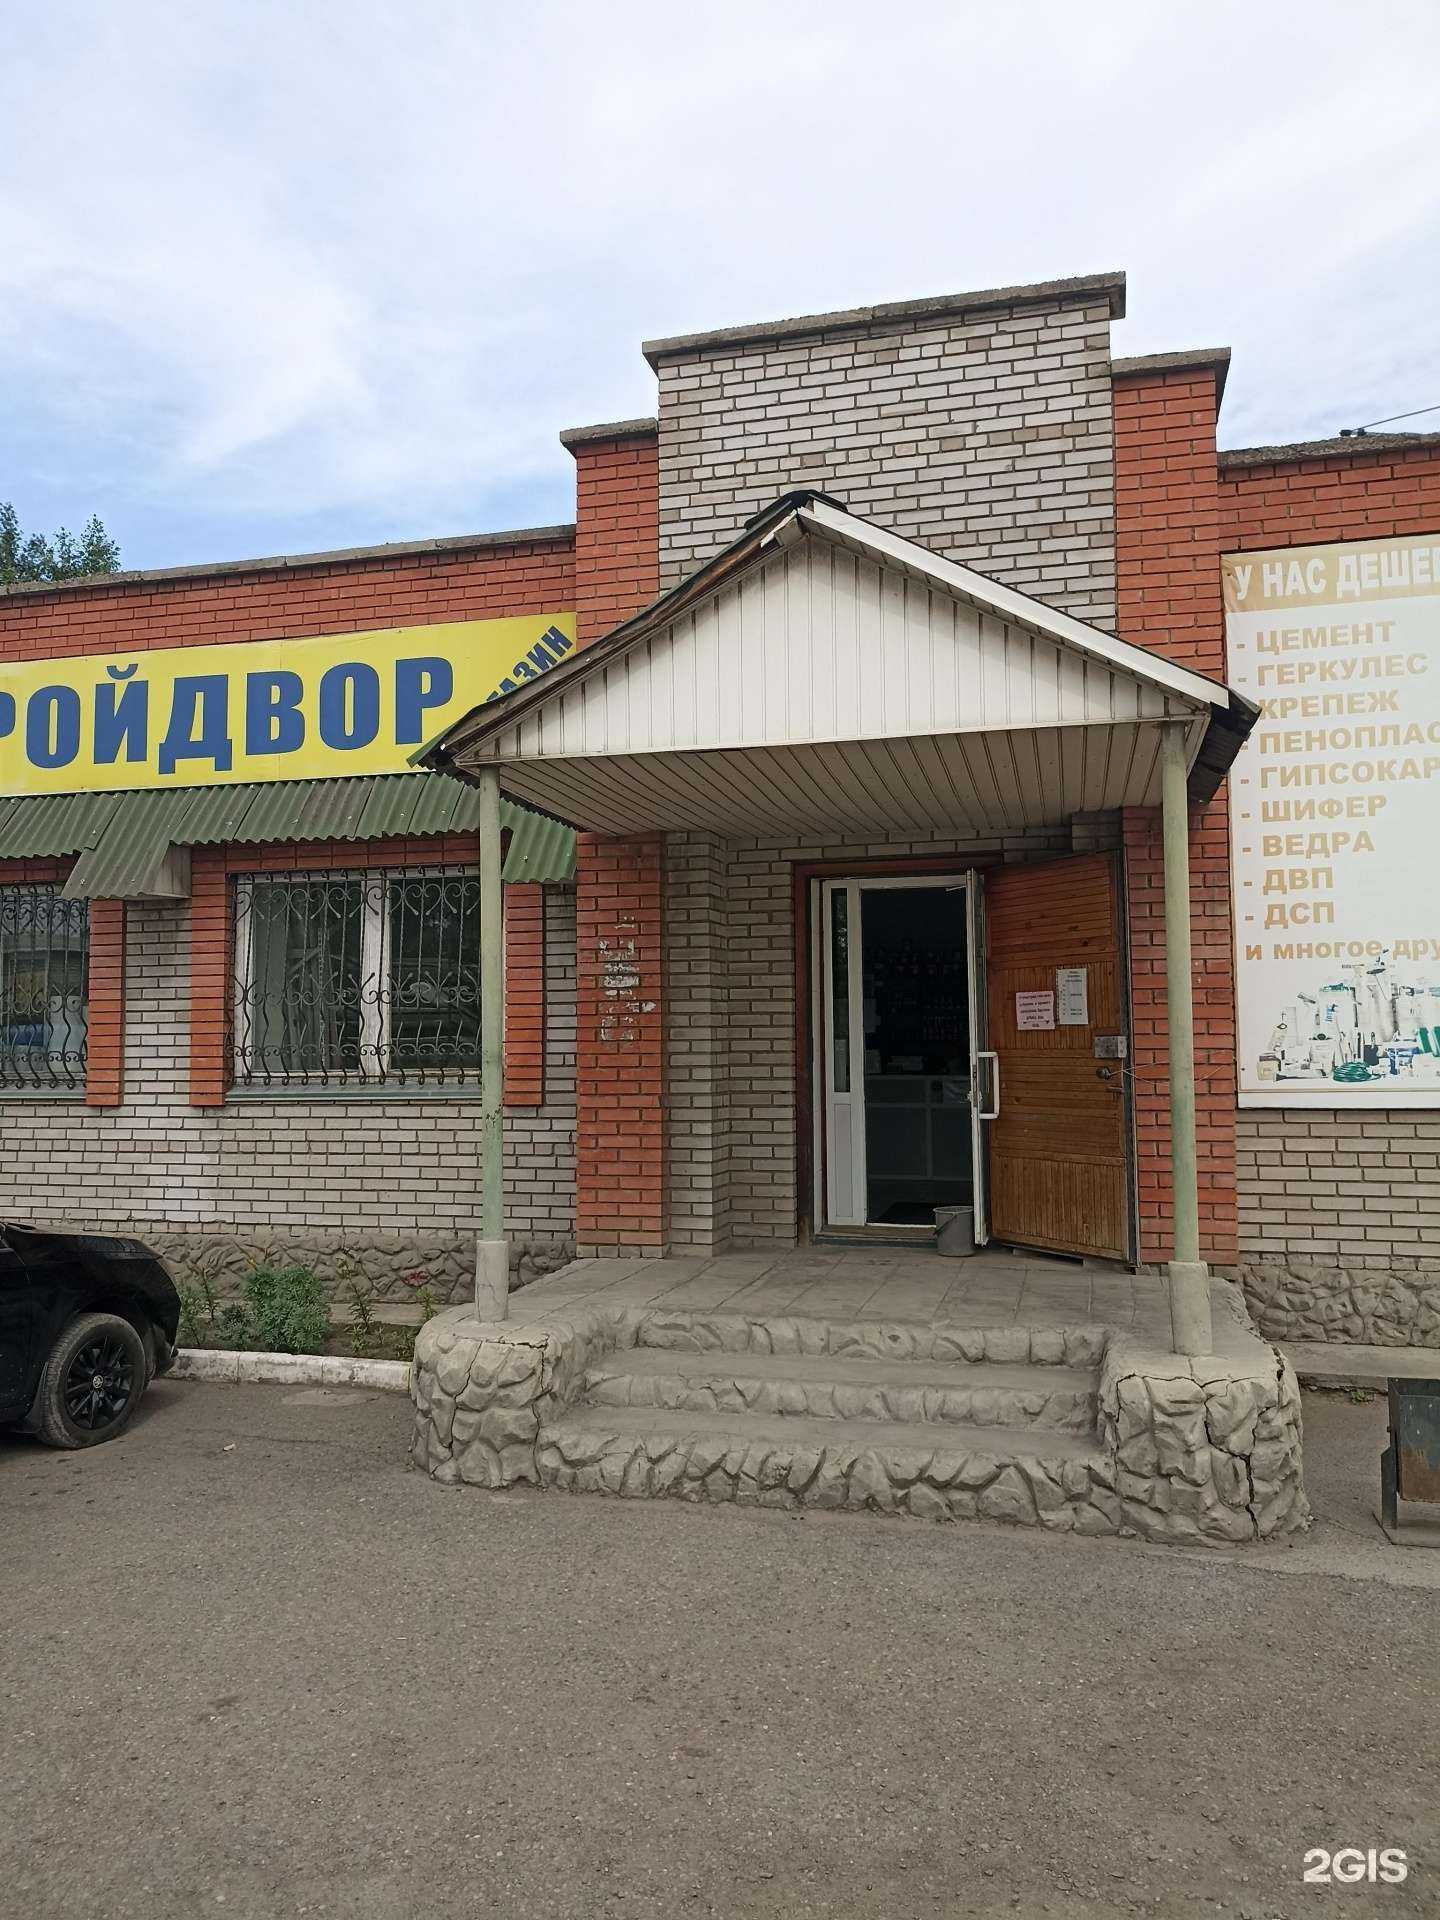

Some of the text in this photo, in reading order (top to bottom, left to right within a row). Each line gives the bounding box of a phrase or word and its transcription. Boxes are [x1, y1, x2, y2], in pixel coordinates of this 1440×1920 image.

[1234, 564, 1251, 600] У
[1262, 558, 1327, 598] НАС
[1256, 620, 1396, 655] ЦЕМЕНТ
[486, 625, 573, 702] ЗИН
[1257, 653, 1429, 687] ГЕРКУЛЕС
[1258, 689, 1400, 720] КРЕПЕЖ
[1260, 756, 1440, 788] ГИПСОКАР
[1261, 795, 1387, 823] ШИФЕР
[1262, 830, 1376, 859] ВЕДРА
[1262, 867, 1334, 896] ДВП
[1264, 901, 1336, 930] ДСП
[1245, 944, 1262, 961] и
[1273, 939, 1383, 960] многое
